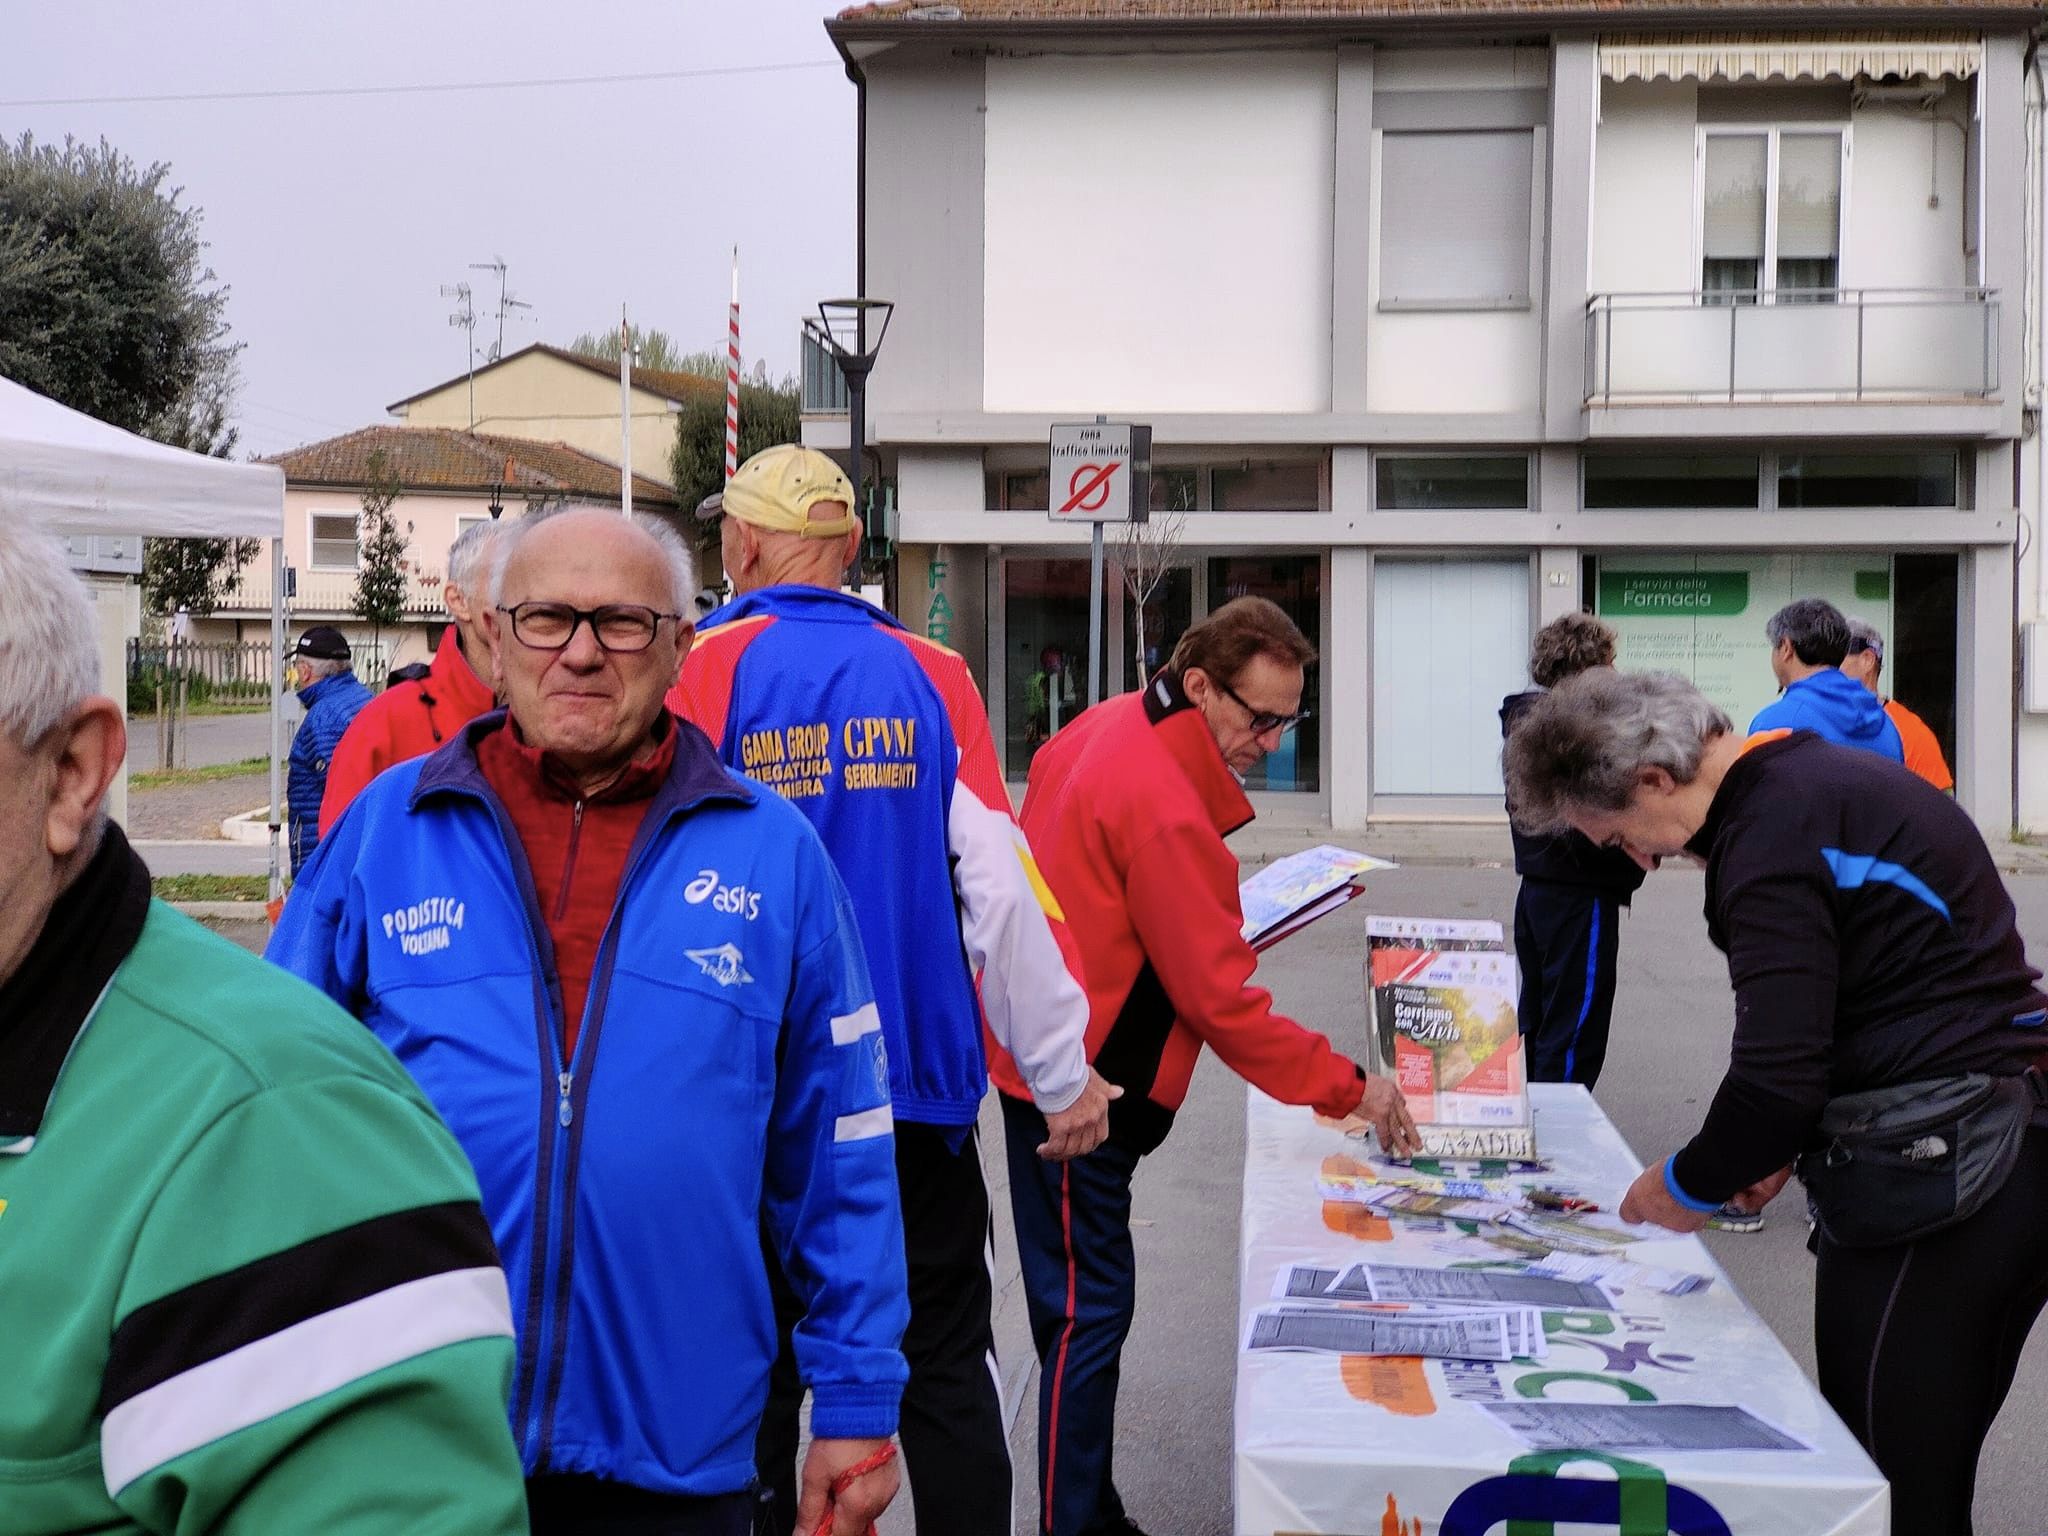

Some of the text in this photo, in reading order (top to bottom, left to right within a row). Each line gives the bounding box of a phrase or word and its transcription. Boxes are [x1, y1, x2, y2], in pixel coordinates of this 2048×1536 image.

[1080, 430, 1101, 440] zona
[1052, 444, 1129, 457] traffico limitato
[1632, 578, 1672, 590] servizi
[1676, 578, 1707, 590] della
[1624, 590, 1712, 607] Farmacia
[742, 724, 829, 766] GAMA GROUP
[844, 717, 916, 759] CPVM
[745, 759, 832, 782] PIEGATURA
[844, 763, 917, 791] SERRAMENTI
[382, 896, 465, 939] PODISTICA
[1395, 1002, 1453, 1028] Corriamo
